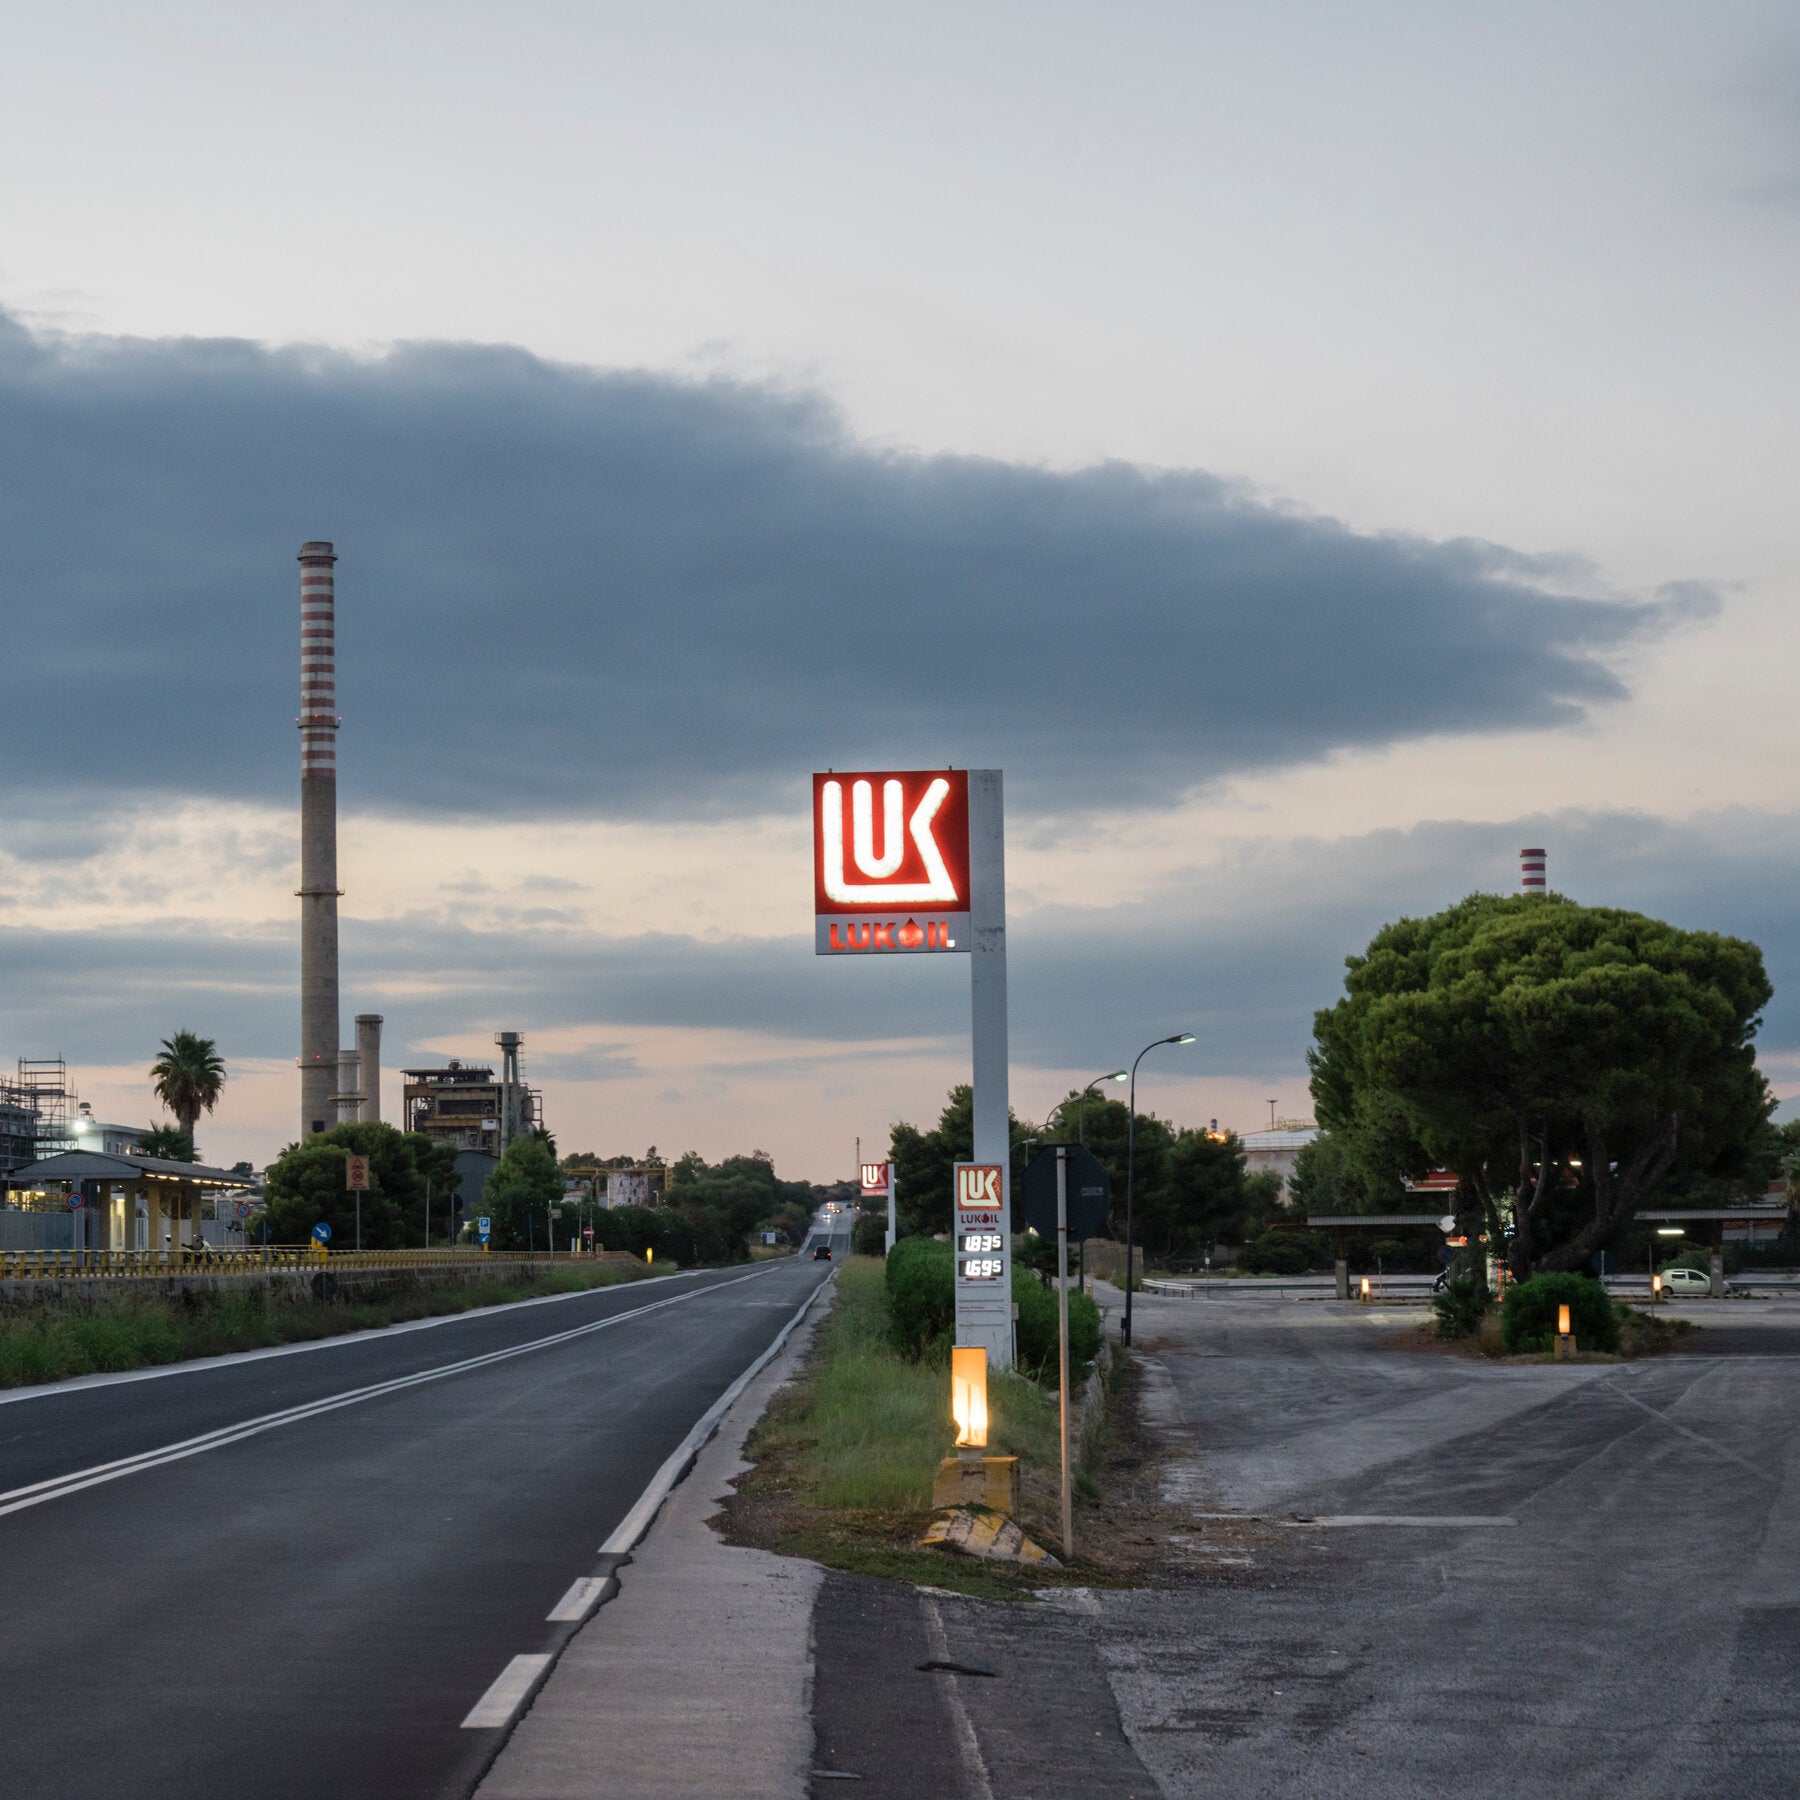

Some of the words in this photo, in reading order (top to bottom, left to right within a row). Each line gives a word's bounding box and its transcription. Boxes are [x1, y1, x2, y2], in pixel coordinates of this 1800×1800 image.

[822, 778, 959, 904] LUK
[829, 918, 955, 950] LUKOIL
[862, 1165, 887, 1188] LUK
[959, 1170, 1000, 1207] LUK
[960, 1212, 999, 1224] LUKOIL
